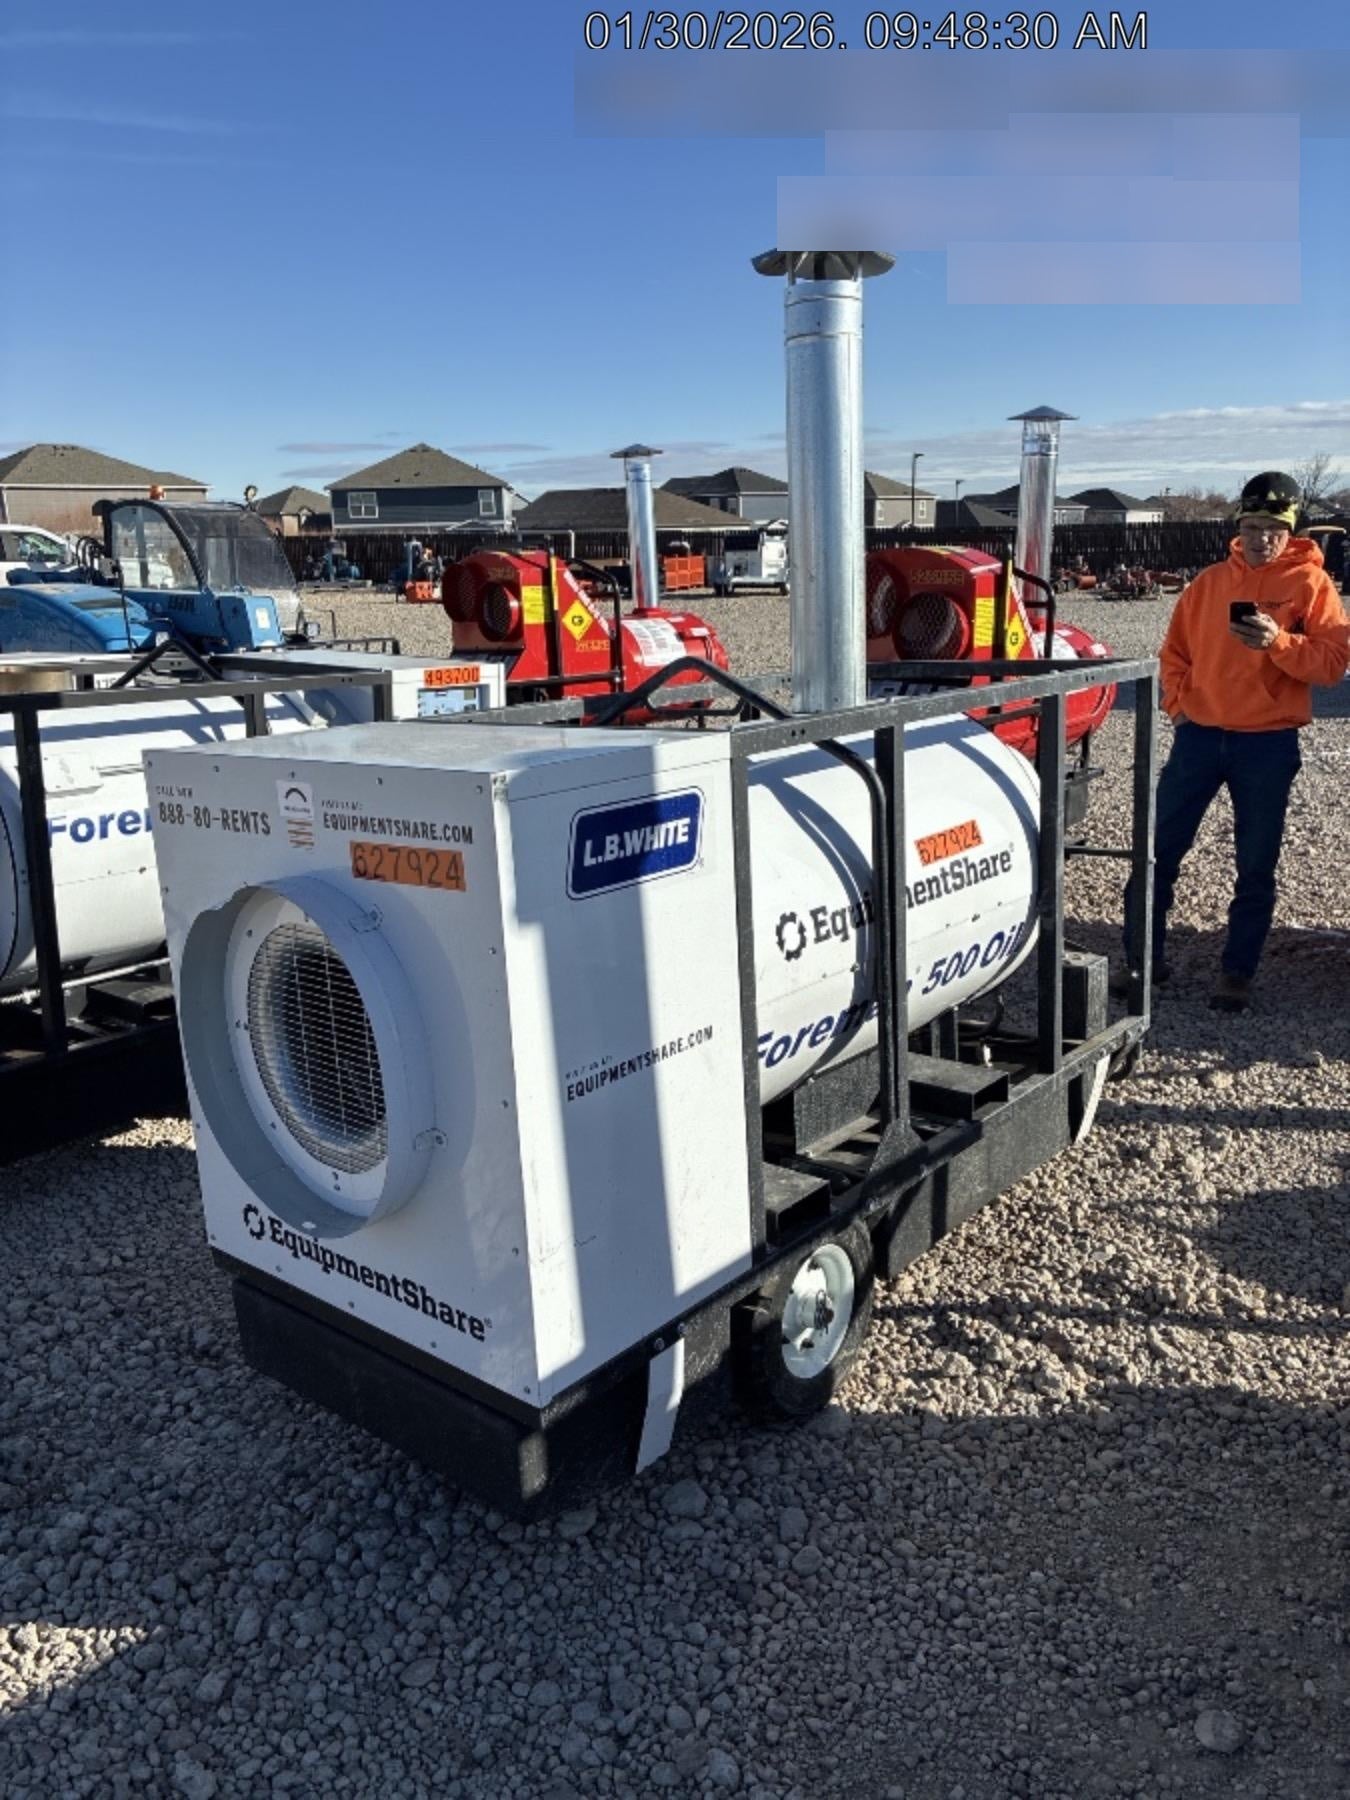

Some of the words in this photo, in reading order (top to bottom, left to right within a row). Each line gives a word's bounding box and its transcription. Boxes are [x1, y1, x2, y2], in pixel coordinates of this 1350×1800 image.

[159, 801, 271, 836] 888-80-RENTS
[323, 812, 474, 845] EQUIPMENTSHARE.COM
[353, 842, 463, 889] 627924
[917, 820, 982, 865] 627924
[922, 943, 981, 995] 500
[567, 1024, 713, 1102] EQUIPMENTSHARE.COM
